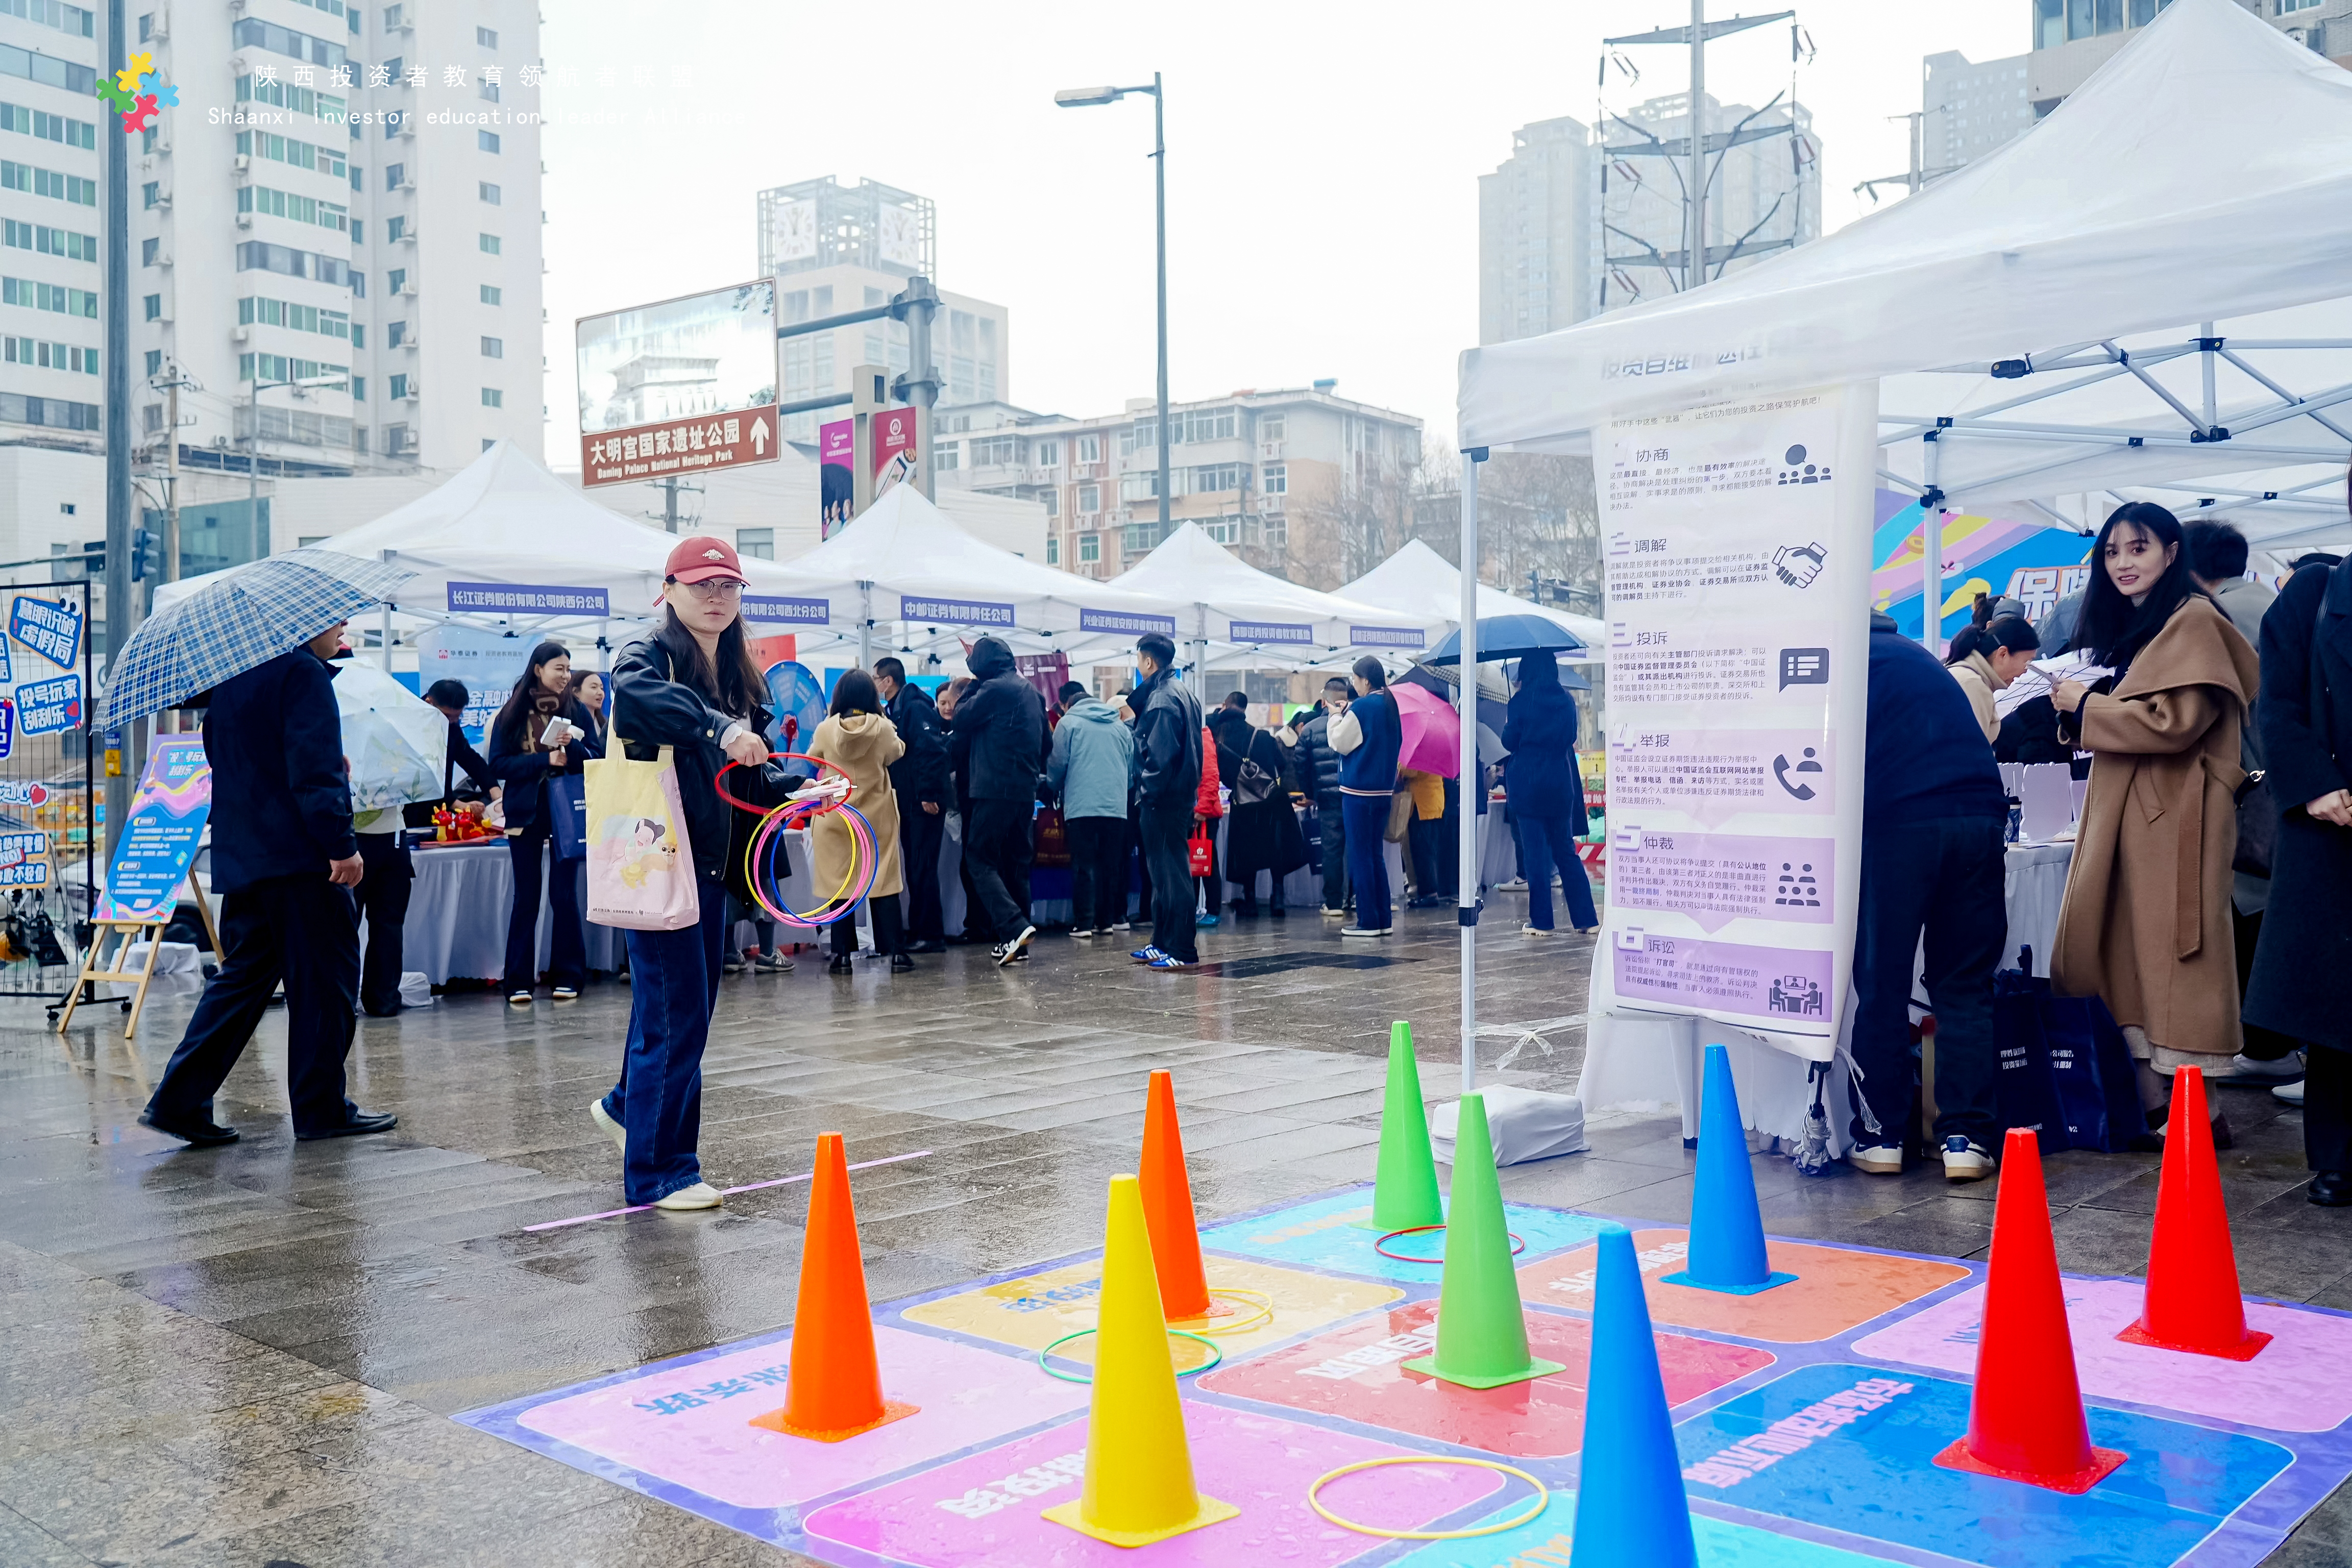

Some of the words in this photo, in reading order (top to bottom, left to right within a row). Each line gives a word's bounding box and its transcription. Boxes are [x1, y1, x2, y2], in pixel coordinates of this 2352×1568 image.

[590, 418, 740, 465] 大明宫国家遗址公园
[597, 467, 623, 479] Daming
[624, 463, 649, 475] Palace
[651, 457, 680, 472] National
[682, 453, 713, 468] Heritage
[715, 449, 733, 462] Park
[1635, 448, 1669, 462] 协商
[1634, 538, 1667, 553] 调解
[453, 590, 605, 610] 长江证券股份有限公司陕西分公司
[905, 602, 1012, 624] 中邮证券有限责任公司
[1636, 631, 1668, 646] 投诉
[18, 678, 78, 709] 投号玩家
[22, 703, 66, 731] 刮刮乐
[1640, 733, 1670, 748] 举报
[0, 782, 30, 801] 动心
[1644, 836, 1674, 850] 仲裁
[1648, 939, 1675, 954] 诉讼
